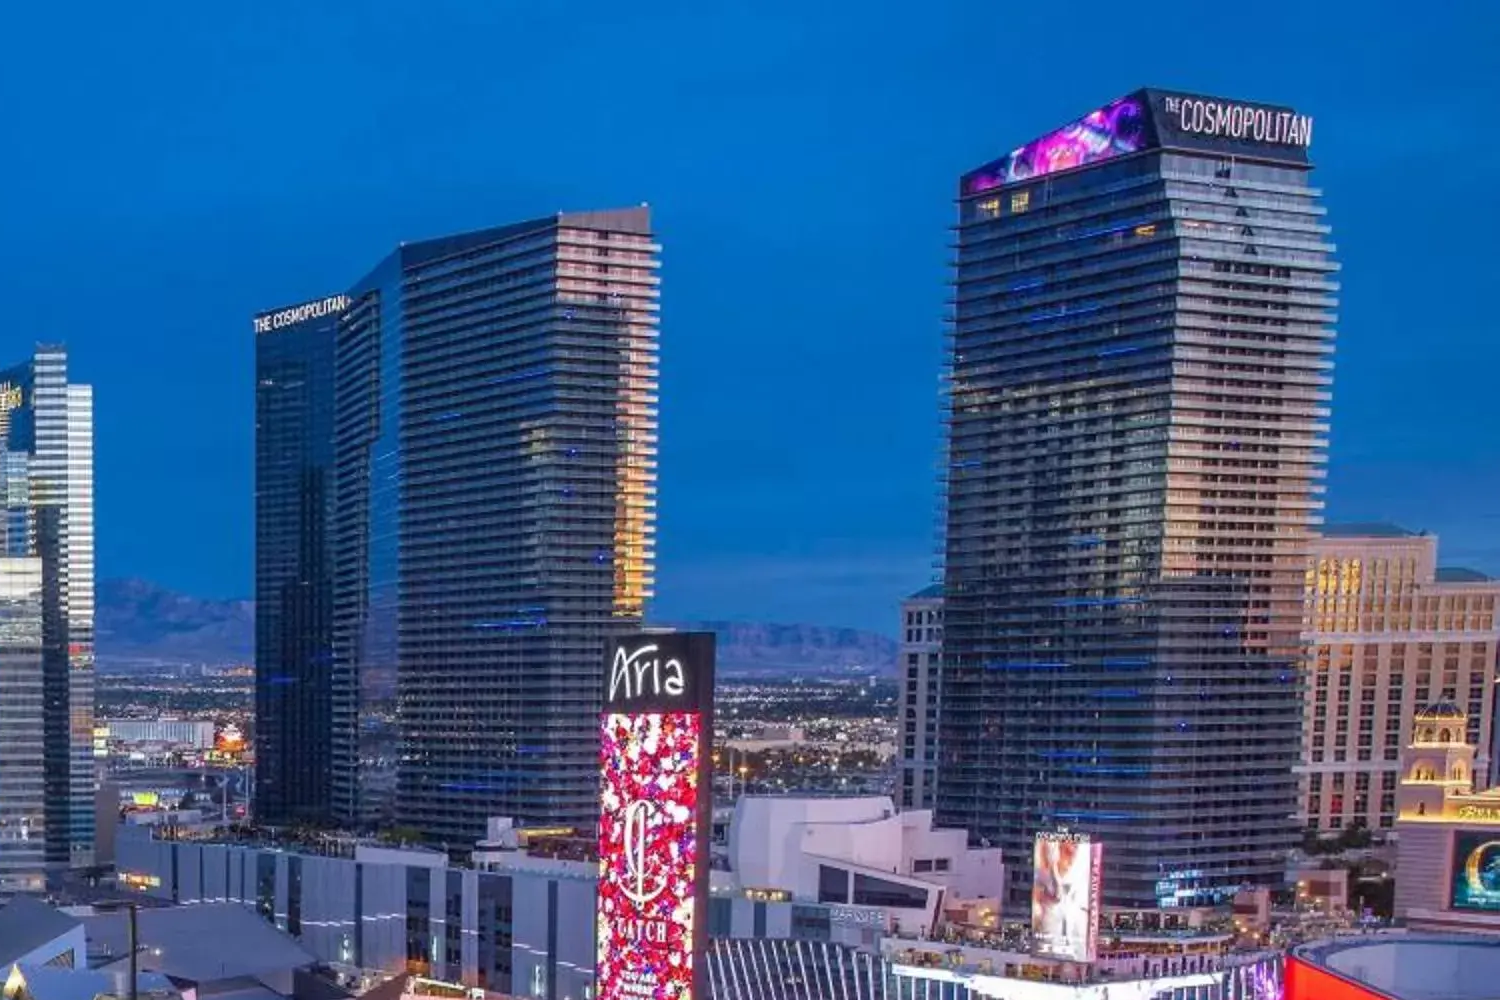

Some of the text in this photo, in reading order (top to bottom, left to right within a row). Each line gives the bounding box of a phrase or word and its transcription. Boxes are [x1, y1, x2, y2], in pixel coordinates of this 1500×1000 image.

[1165, 97, 1313, 147] THE COSMOPOLITAN
[253, 295, 347, 334] THE COSMOPOLITAN
[609, 644, 685, 702] Aria
